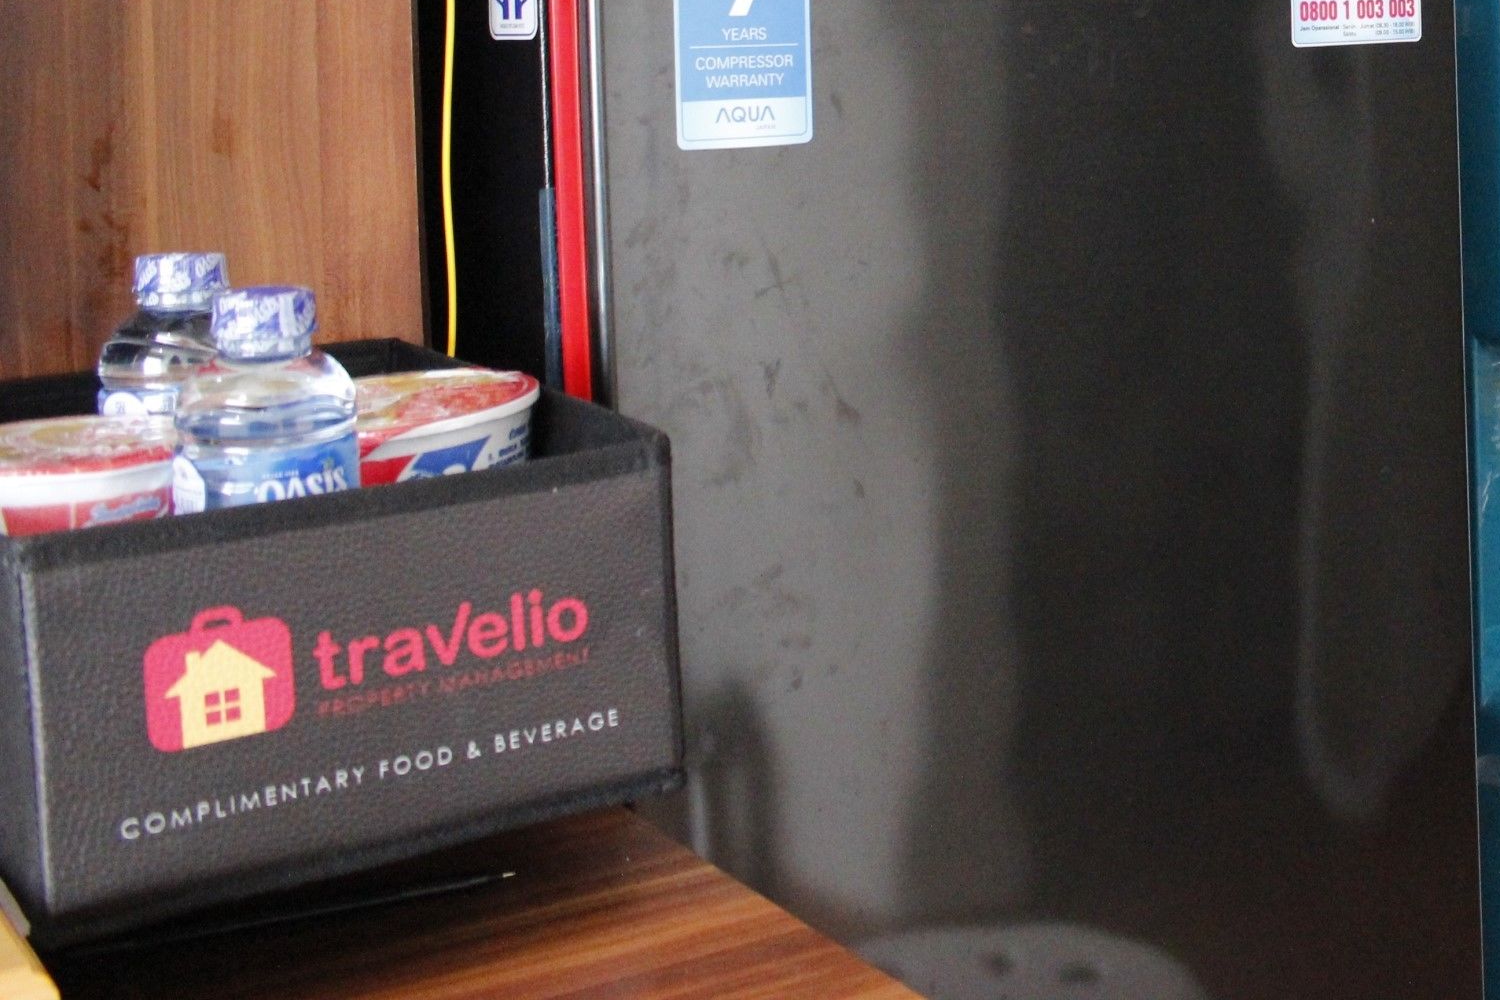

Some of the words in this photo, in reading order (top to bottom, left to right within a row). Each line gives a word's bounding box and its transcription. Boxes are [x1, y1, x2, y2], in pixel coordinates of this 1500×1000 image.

[1299, 0, 1338, 22] 0800
[1343, 0, 1350, 21] 1
[721, 27, 768, 42] YEARS
[694, 54, 794, 71] COMPRESSOR
[705, 73, 785, 89] WARRANTY
[715, 105, 776, 124] AQUA
[313, 588, 589, 691] travelio
[317, 679, 430, 717] PROPERTY
[439, 647, 590, 692] MANAGEMENT
[119, 765, 366, 841] COMPLIMENTARY
[378, 746, 454, 780] FOOD
[465, 740, 482, 760] &
[494, 708, 620, 753] BEVERAGE
